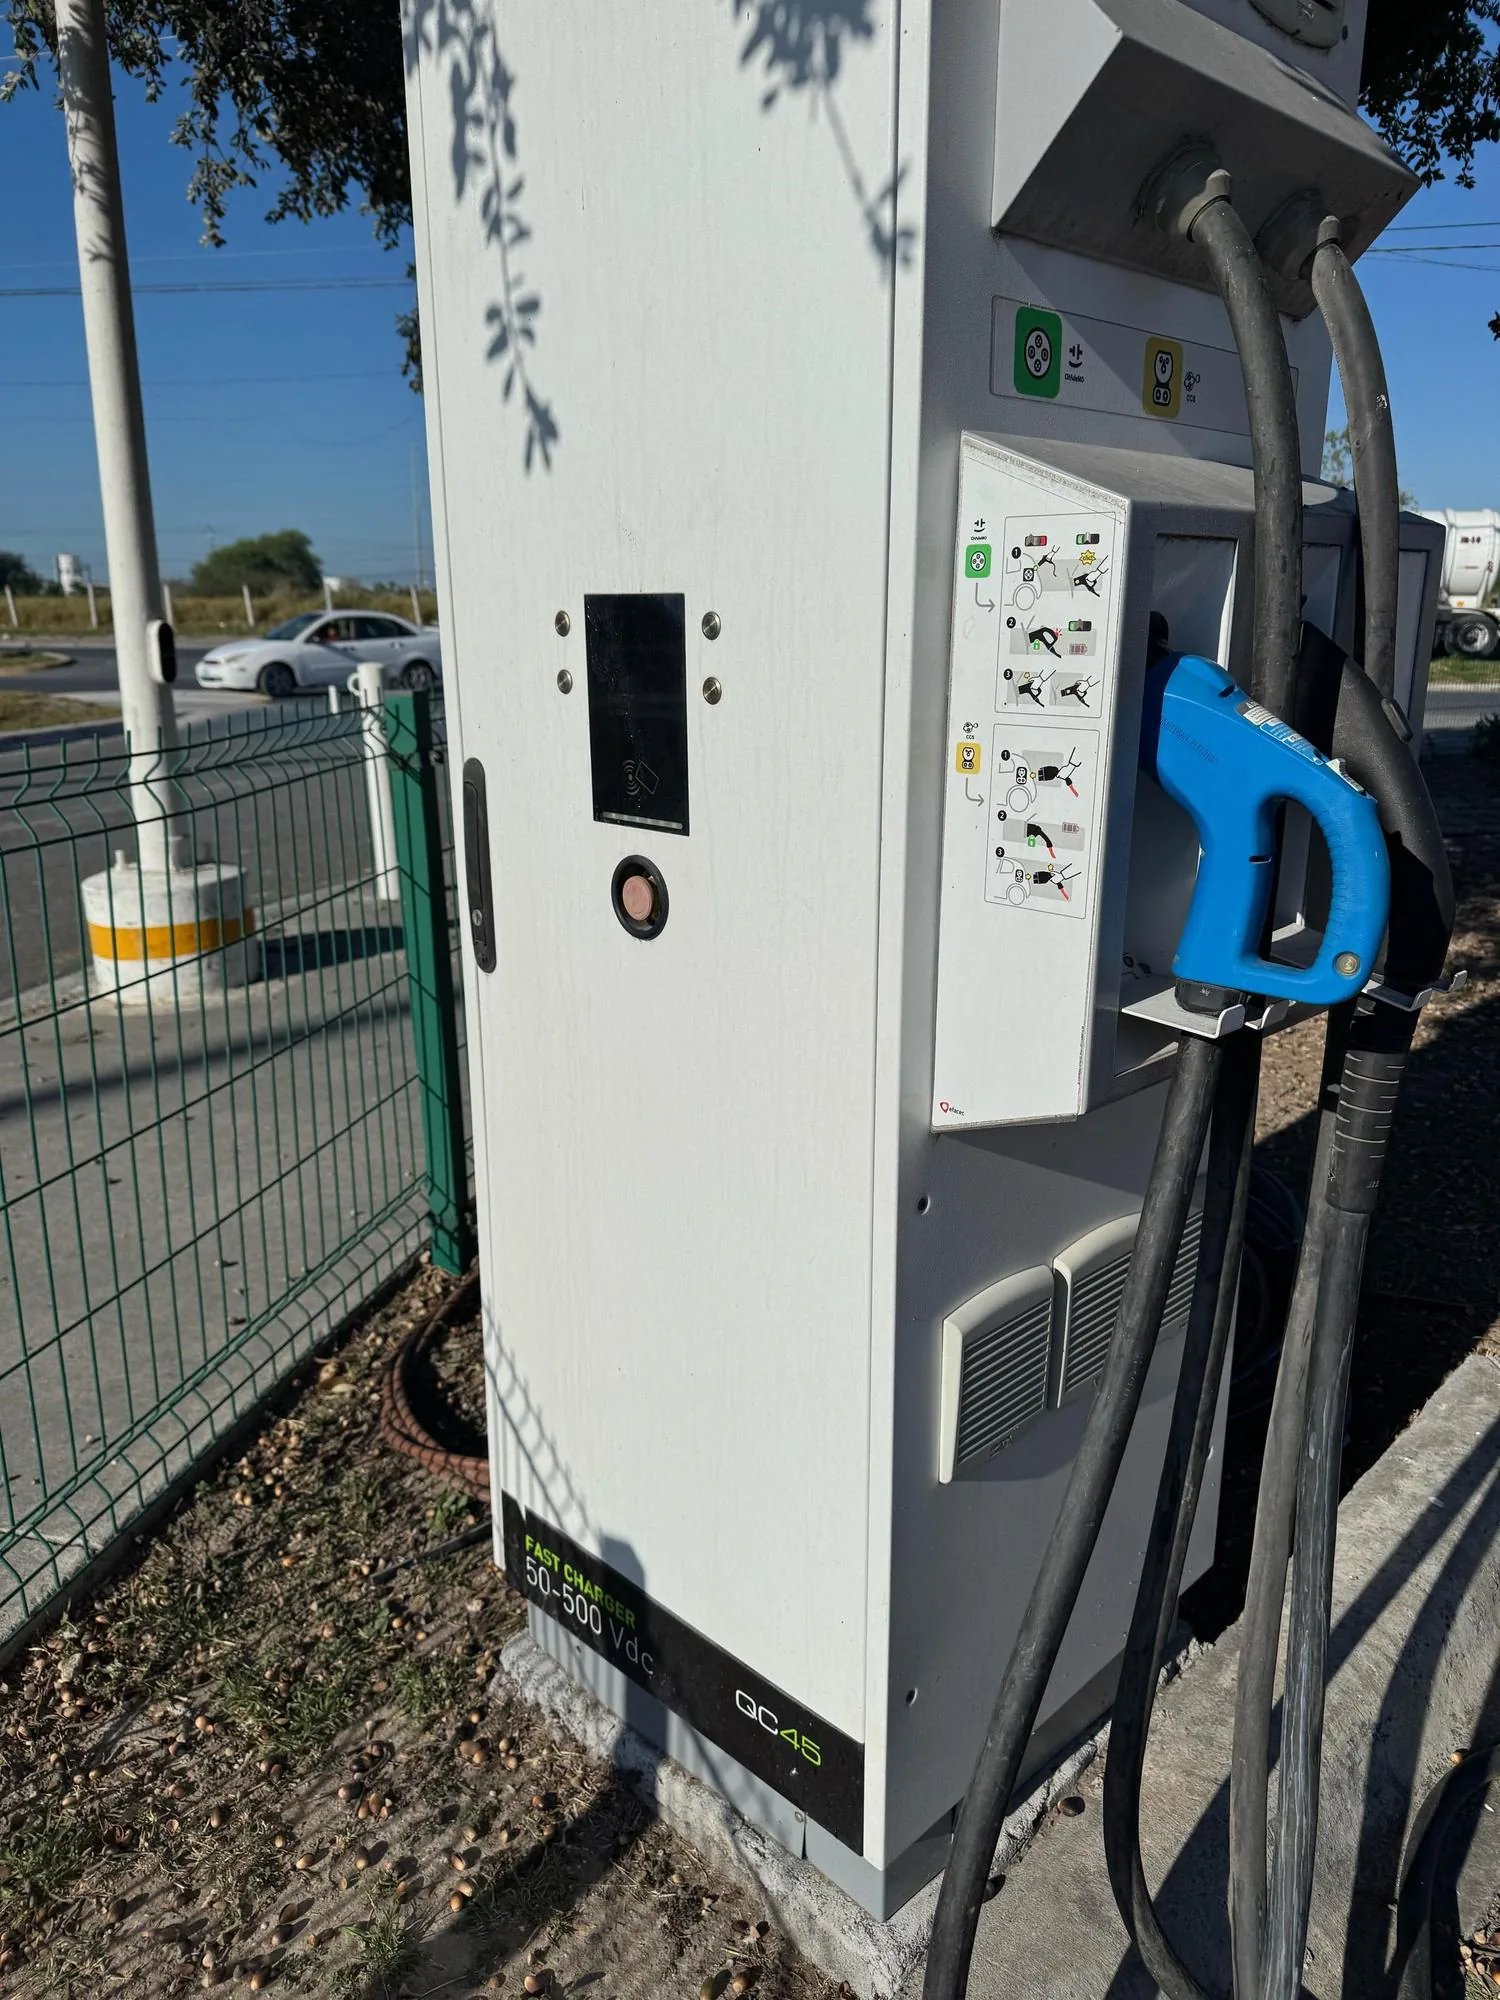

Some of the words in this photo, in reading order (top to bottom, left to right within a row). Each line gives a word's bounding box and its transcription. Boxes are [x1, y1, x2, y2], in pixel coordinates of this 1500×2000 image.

[525, 1534, 560, 1572] FAST
[563, 1563, 636, 1629] CHARGER
[526, 1556, 602, 1635] 50-500
[609, 1617, 654, 1675] Vdc
[735, 1689, 822, 1767] QC45
